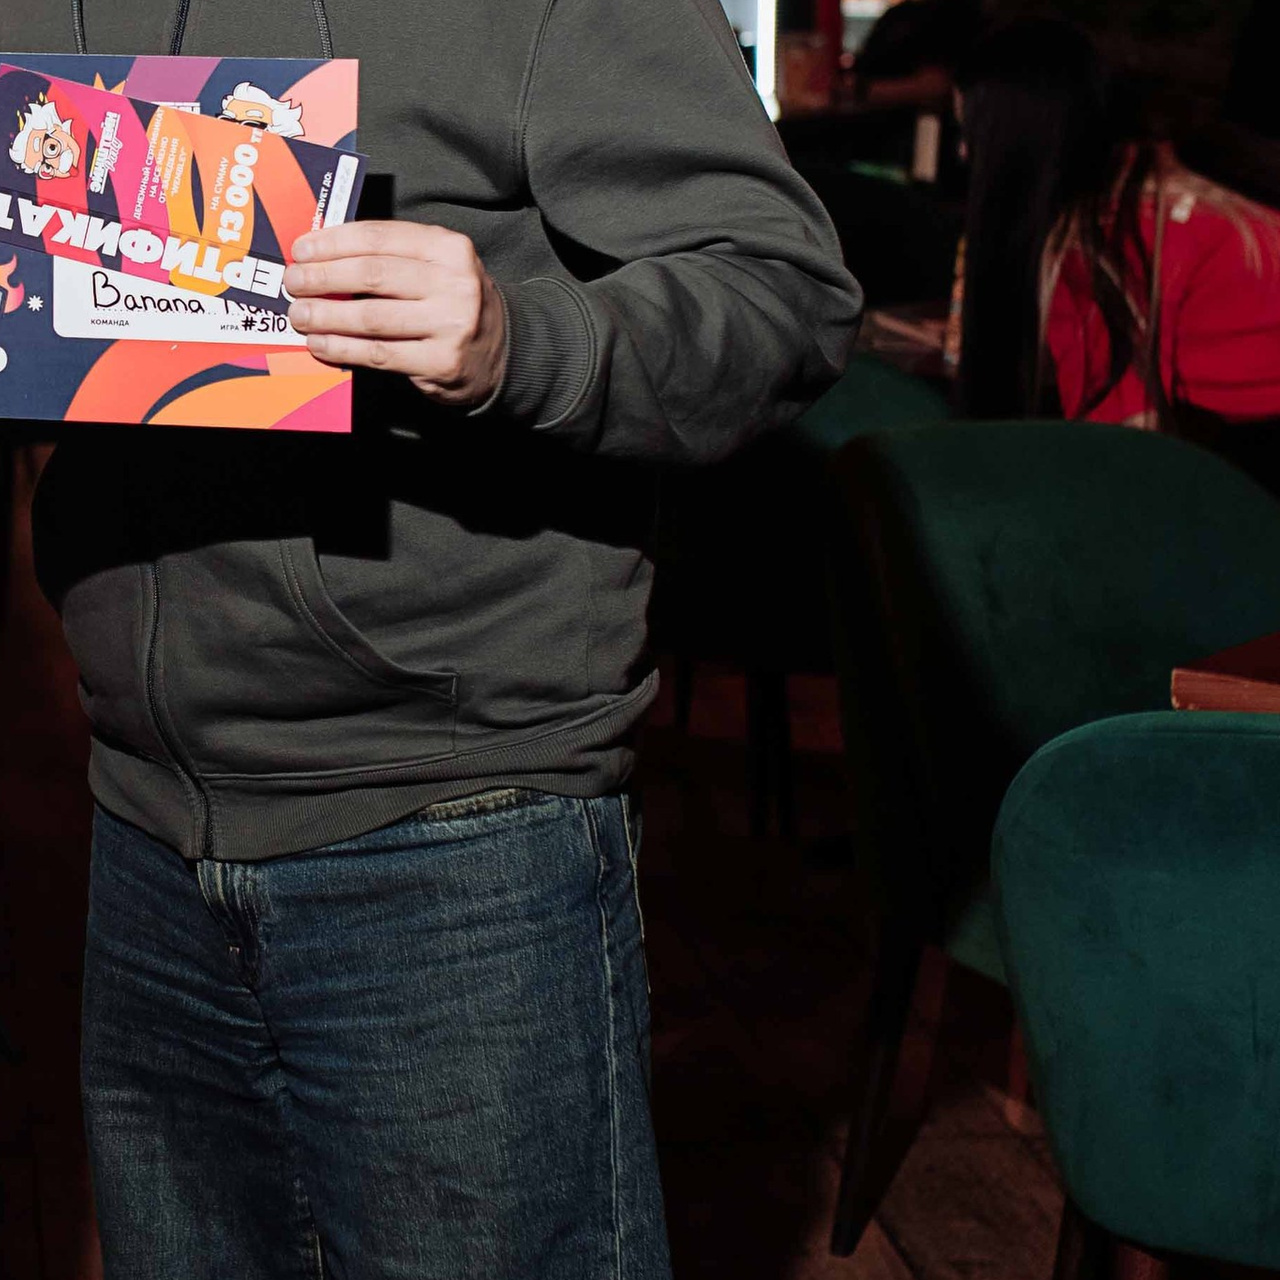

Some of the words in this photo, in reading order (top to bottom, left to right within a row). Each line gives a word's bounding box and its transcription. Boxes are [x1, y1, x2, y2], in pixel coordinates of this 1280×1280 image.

[156, 136, 169, 165] МЕНЮ
[152, 167, 161, 184] ВСЕ
[224, 143, 259, 207] 000
[322, 171, 333, 188] ДО:
[148, 185, 157, 198] НА
[210, 196, 220, 211] НА
[215, 157, 228, 194] СУММУ
[133, 166, 151, 220] ДЕНЕЖНЫЙ
[158, 191, 166, 204] ОТ
[217, 209, 245, 244] 13
[92, 270, 205, 314] Banana
[91, 318, 130, 327] КОМАНДА
[220, 324, 239, 332] ИГРА
[241, 316, 287, 333] #510
